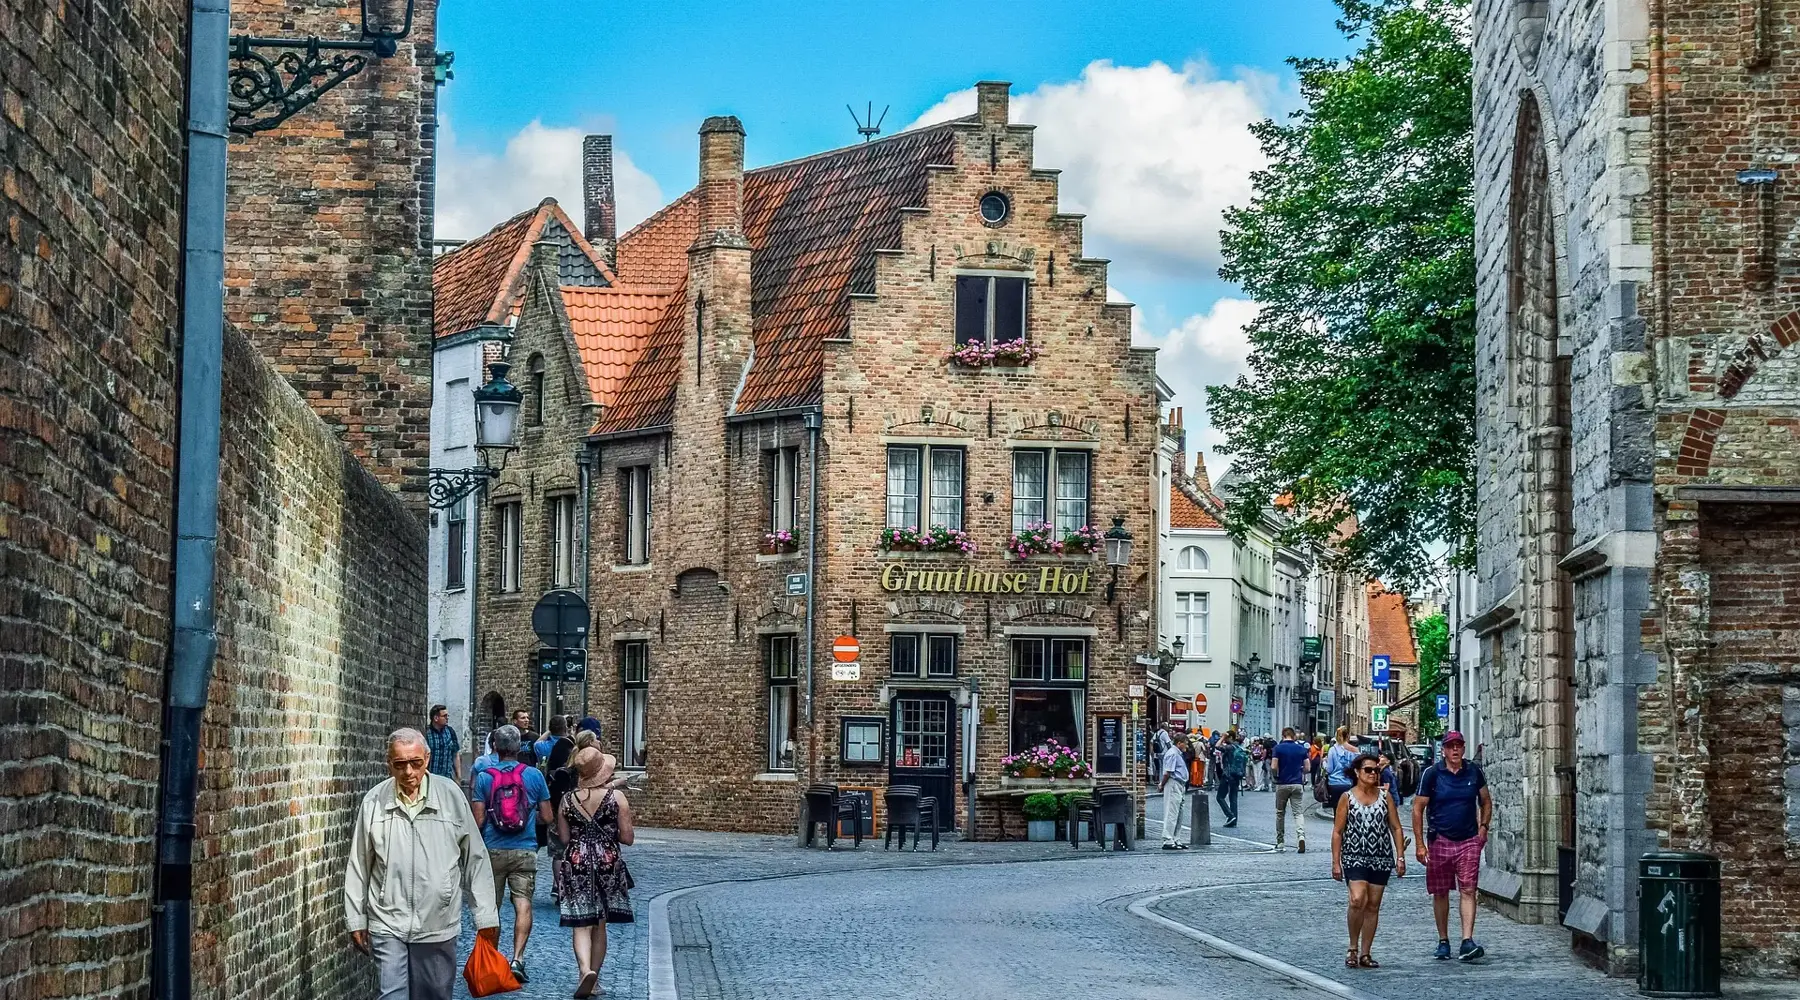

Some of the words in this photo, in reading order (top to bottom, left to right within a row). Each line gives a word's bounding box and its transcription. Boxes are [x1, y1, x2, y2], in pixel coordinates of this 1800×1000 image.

[882, 564, 1028, 593] Gruuthuse
[1036, 566, 1093, 594] Hof
[1374, 658, 1387, 677] P
[1438, 697, 1447, 710] P
